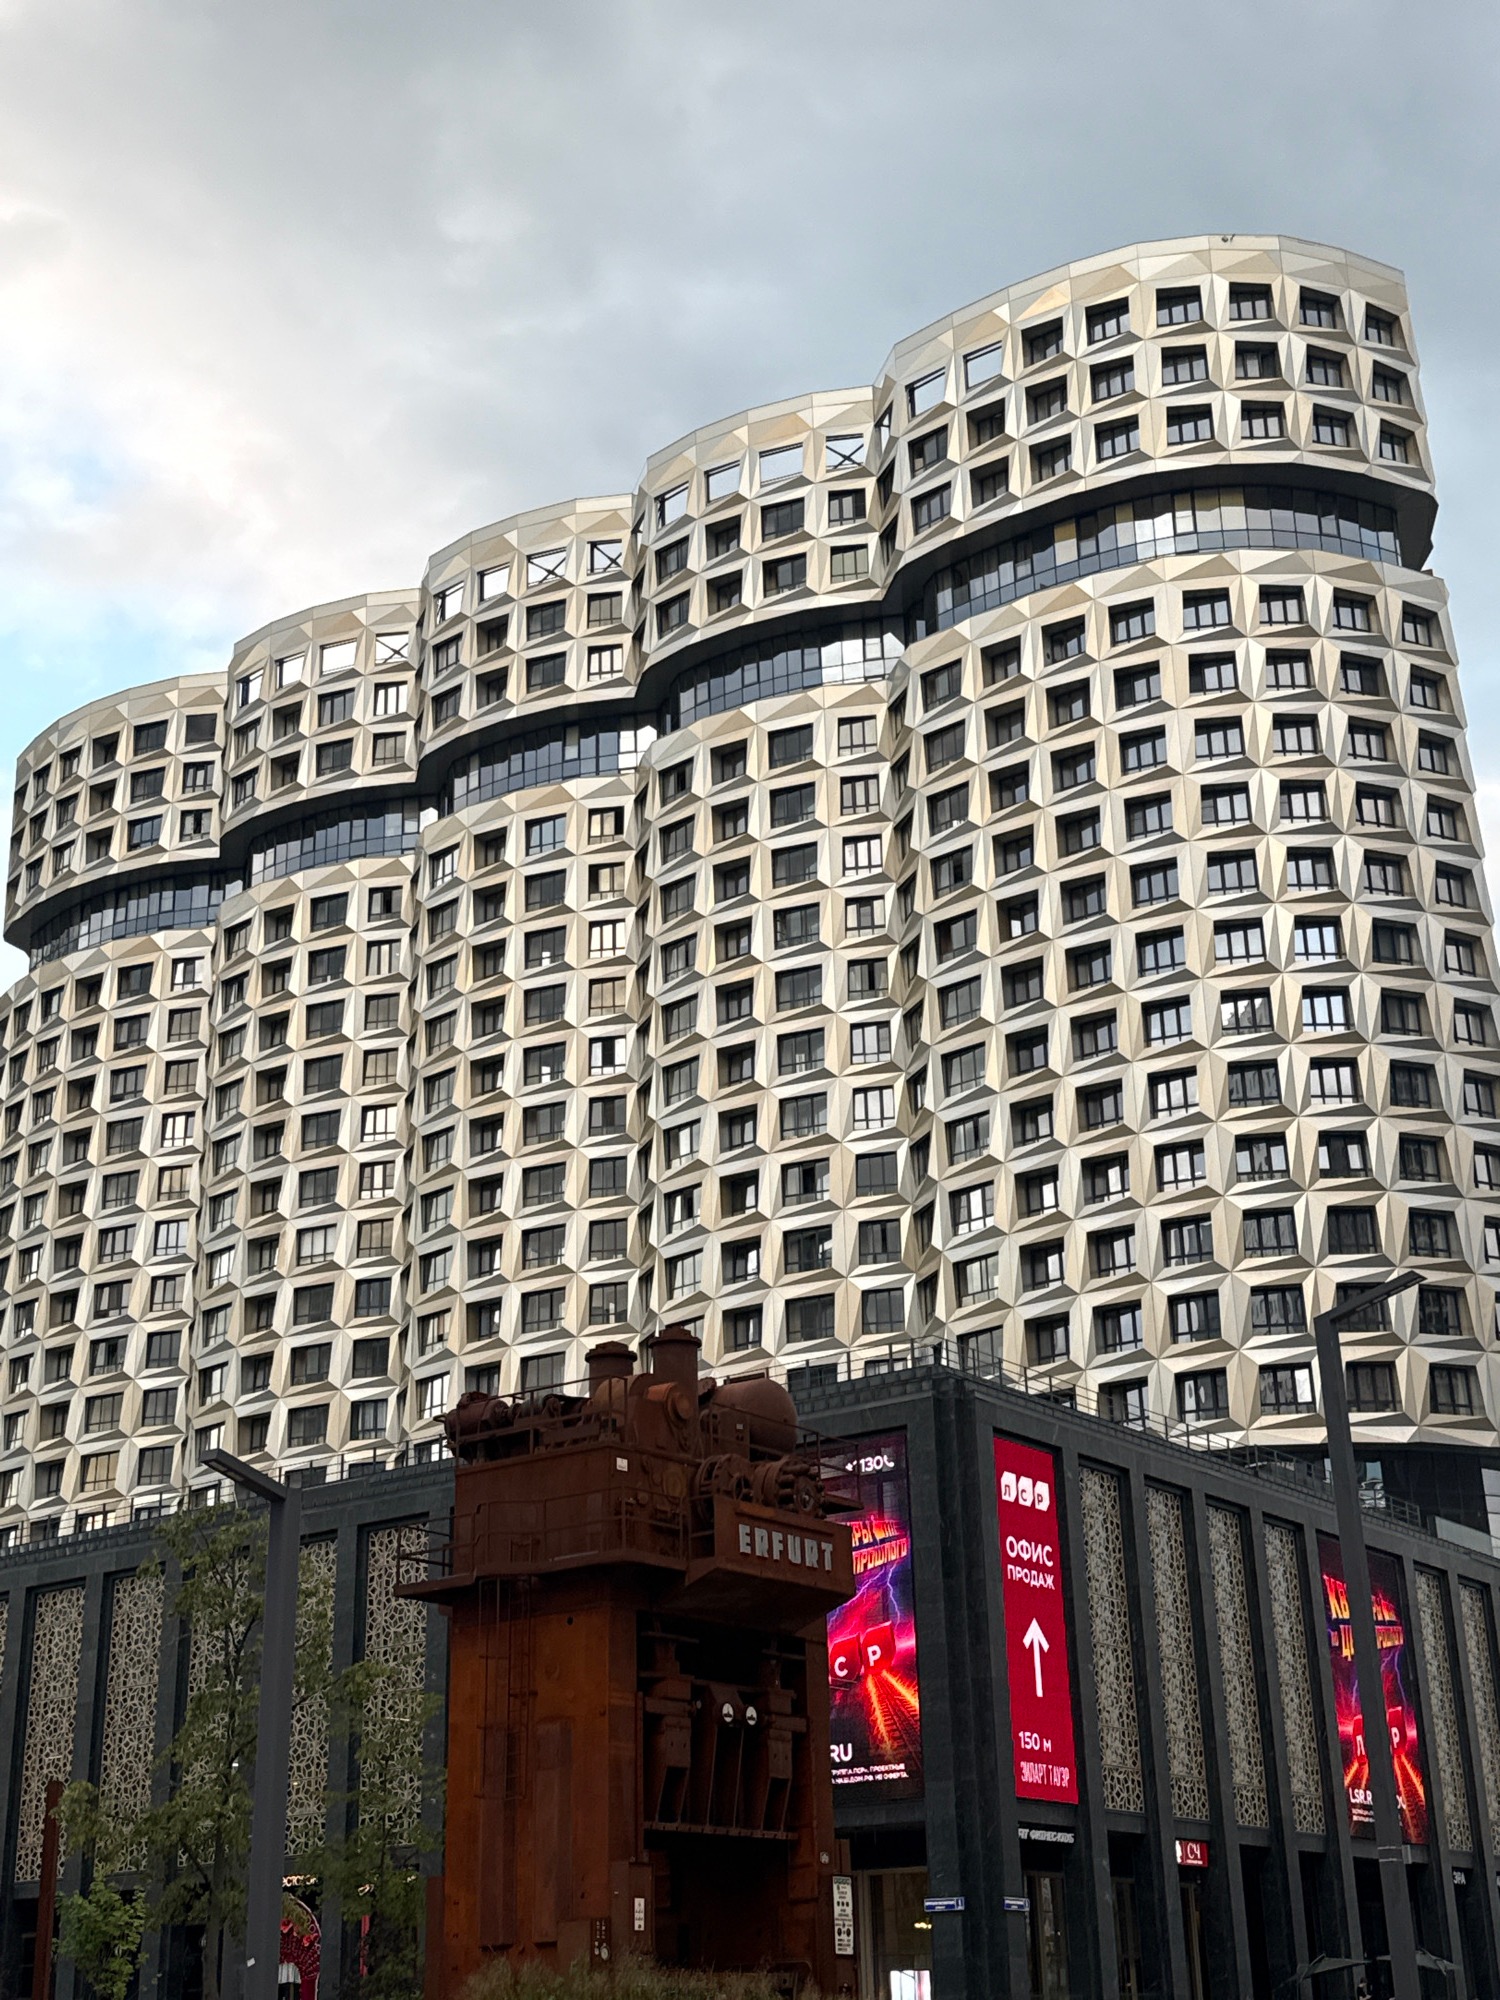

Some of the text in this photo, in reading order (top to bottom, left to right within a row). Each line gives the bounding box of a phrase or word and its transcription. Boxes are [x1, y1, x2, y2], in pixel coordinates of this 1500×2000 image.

[738, 1524, 833, 1570] ERFURT
[853, 1538, 907, 1574] ПРОШЛОГО
[1005, 1535, 1054, 1567] ОФИС
[1006, 1563, 1056, 1590] ПРОДАЖ
[1018, 1730, 1041, 1751] 150
